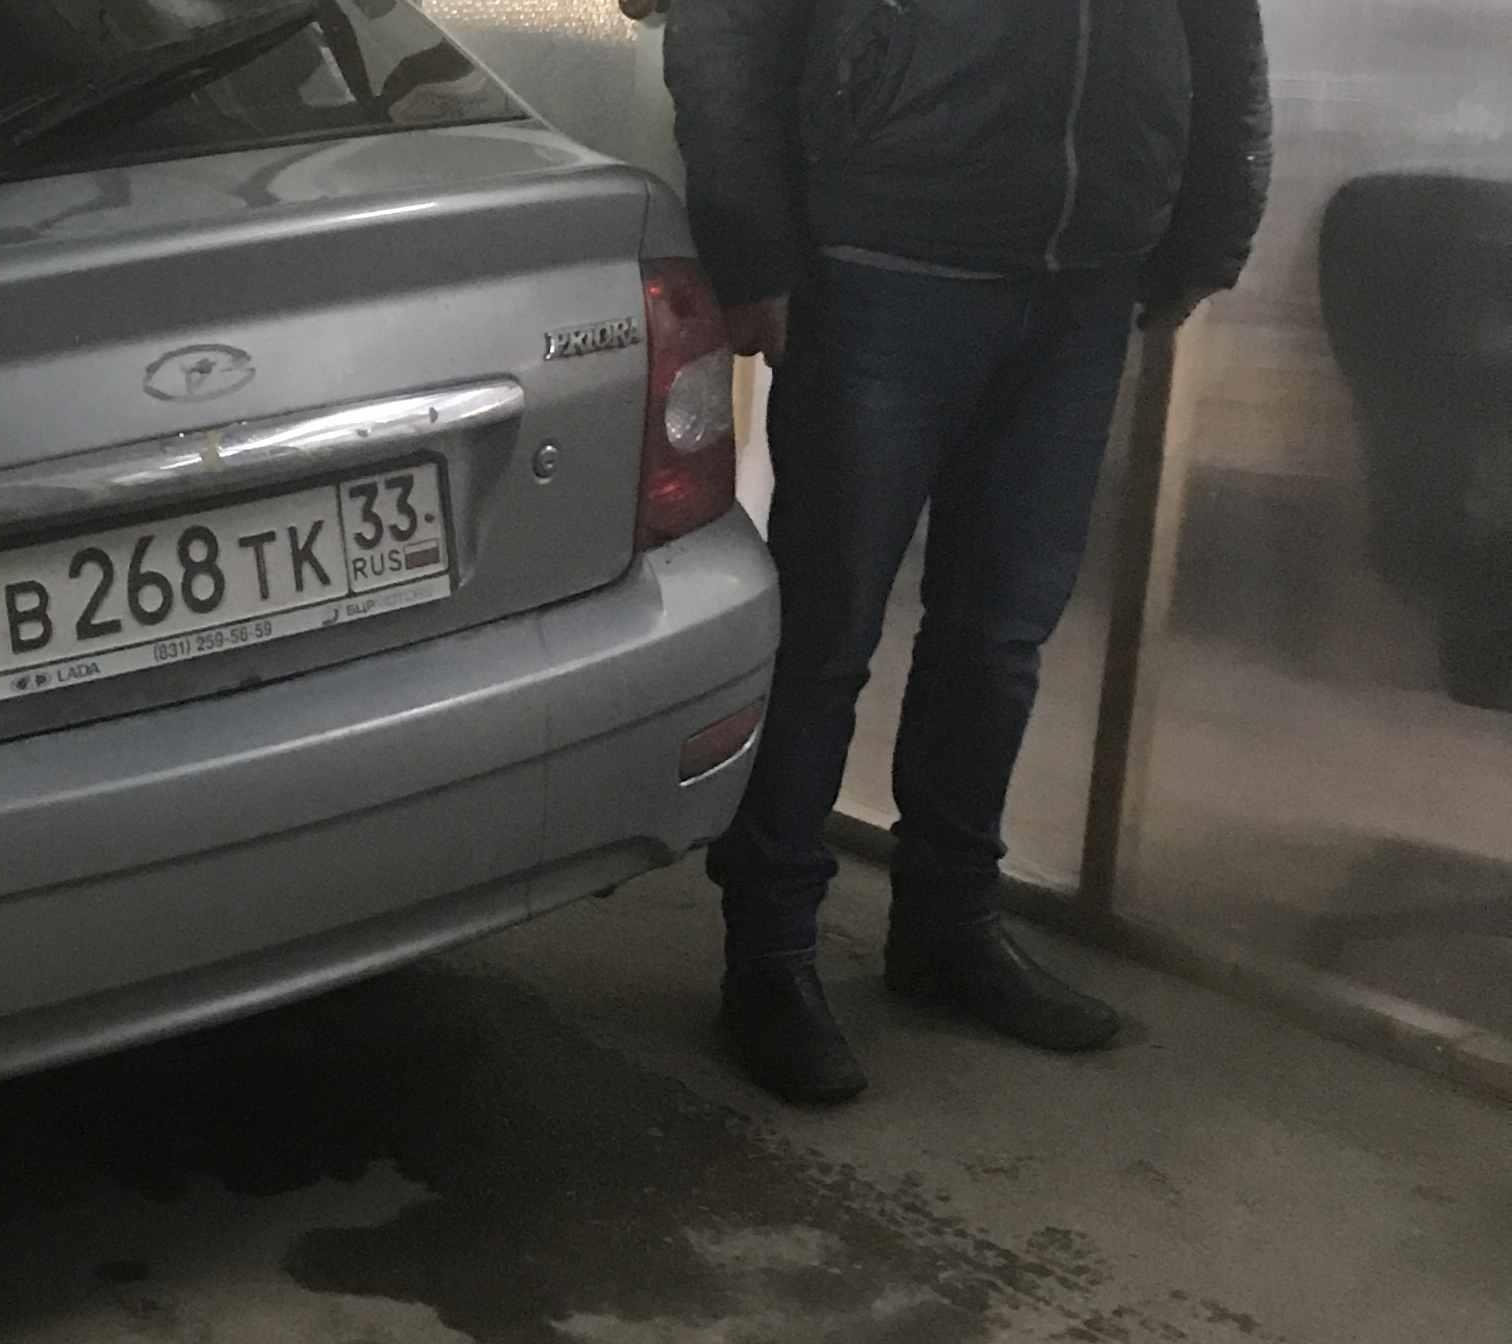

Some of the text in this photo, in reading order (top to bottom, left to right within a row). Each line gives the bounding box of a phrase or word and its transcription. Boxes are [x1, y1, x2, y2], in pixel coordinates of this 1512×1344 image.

[347, 474, 418, 550] 33
[352, 553, 403, 581] RUS
[55, 659, 101, 683] LADA
